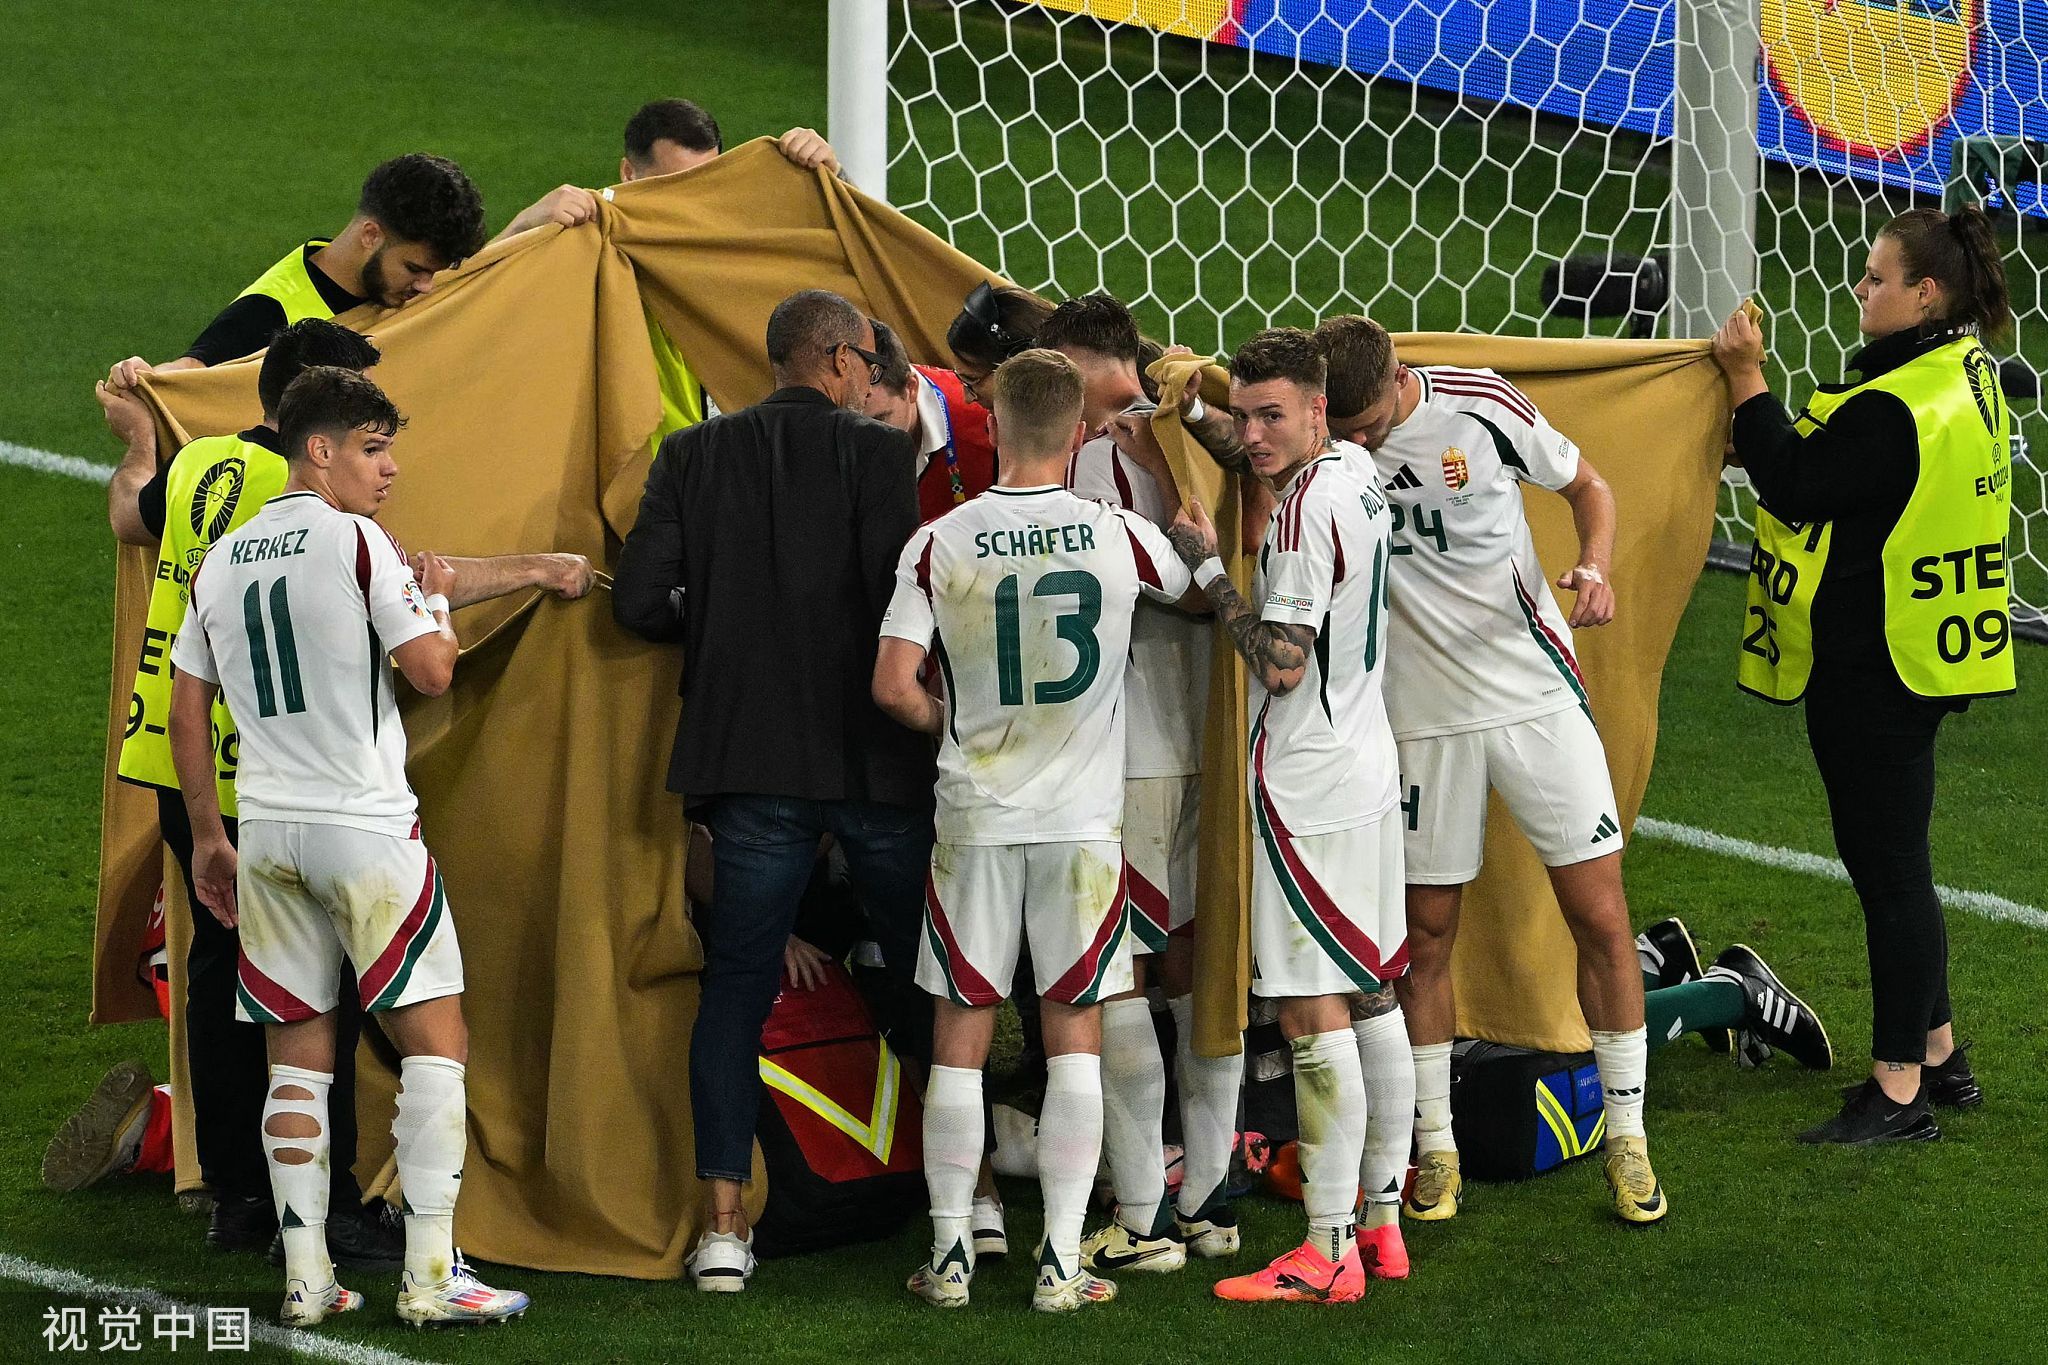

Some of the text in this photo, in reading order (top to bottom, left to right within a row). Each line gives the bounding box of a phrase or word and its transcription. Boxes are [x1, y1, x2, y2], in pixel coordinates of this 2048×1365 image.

[230, 528, 309, 566] KERKEZ
[975, 523, 1096, 558] SCHÄFER
[1389, 503, 1449, 556] 24
[1911, 536, 2008, 600] STE
[1268, 594, 1313, 608] OUNDATION
[243, 575, 307, 718] 11
[995, 570, 1102, 706] 13
[1936, 609, 2009, 664] 09
